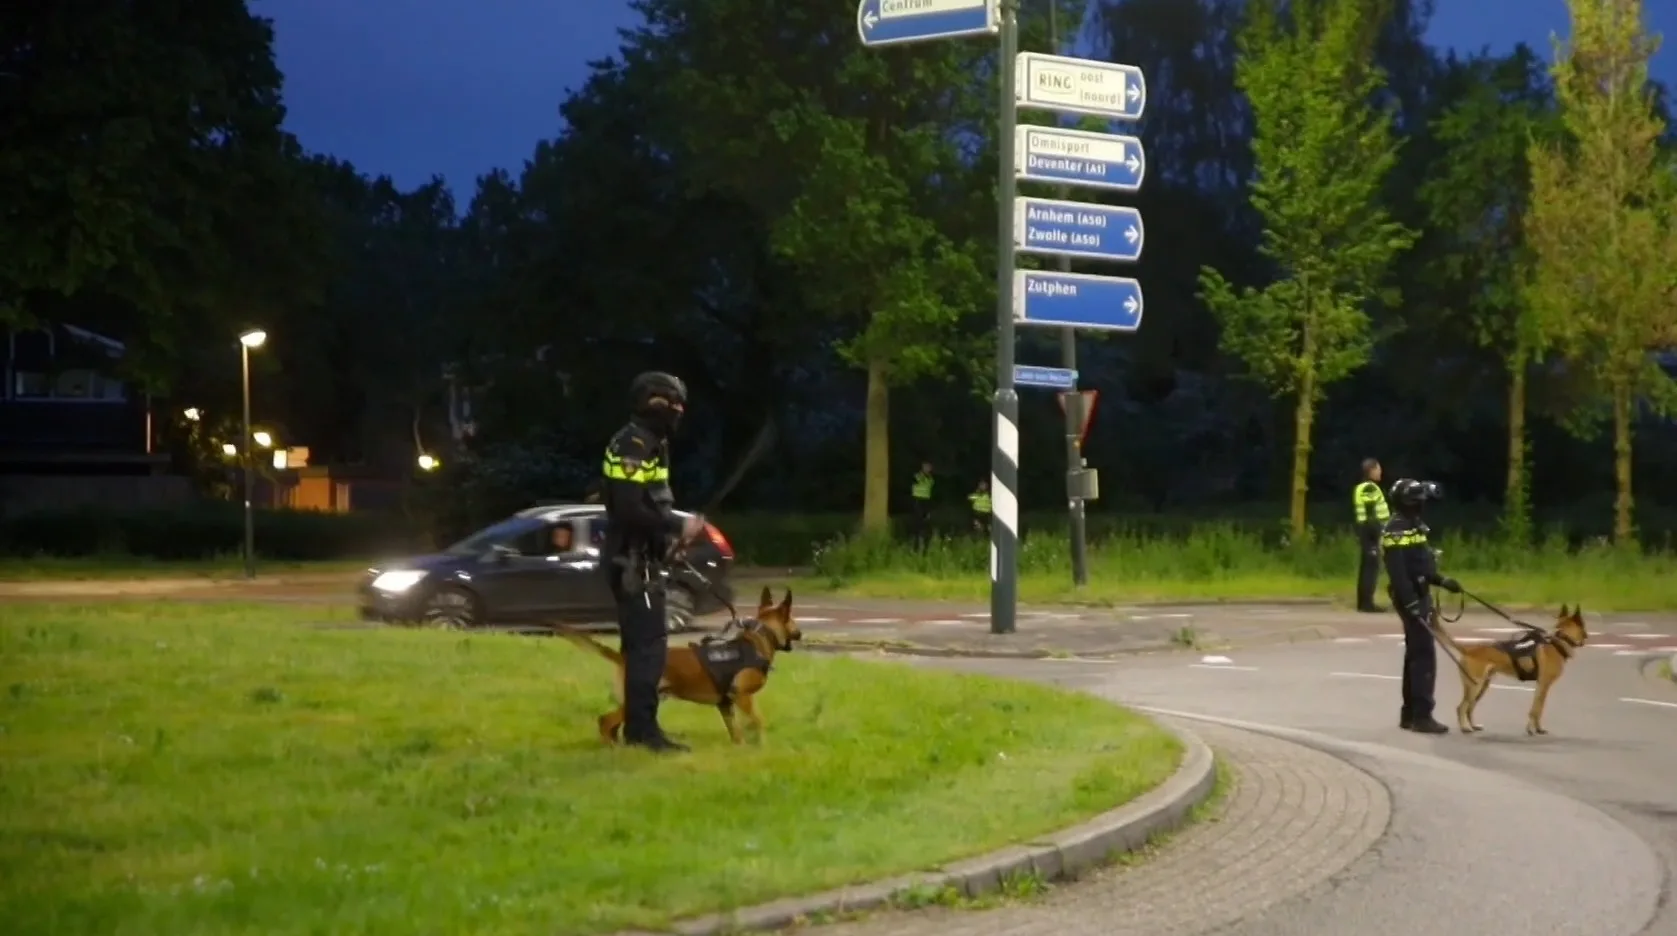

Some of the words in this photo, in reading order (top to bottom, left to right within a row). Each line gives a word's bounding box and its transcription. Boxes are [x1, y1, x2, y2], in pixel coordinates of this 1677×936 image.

[882, 0, 933, 12] Centrum
[1039, 73, 1072, 89] RING
[1080, 72, 1104, 84] oost
[1031, 136, 1090, 154] Omnisport
[1028, 155, 1081, 172] Deventer
[1028, 207, 1074, 224] Arnhem
[1028, 226, 1068, 244] Zwolle
[1027, 279, 1077, 297] Zutphen
